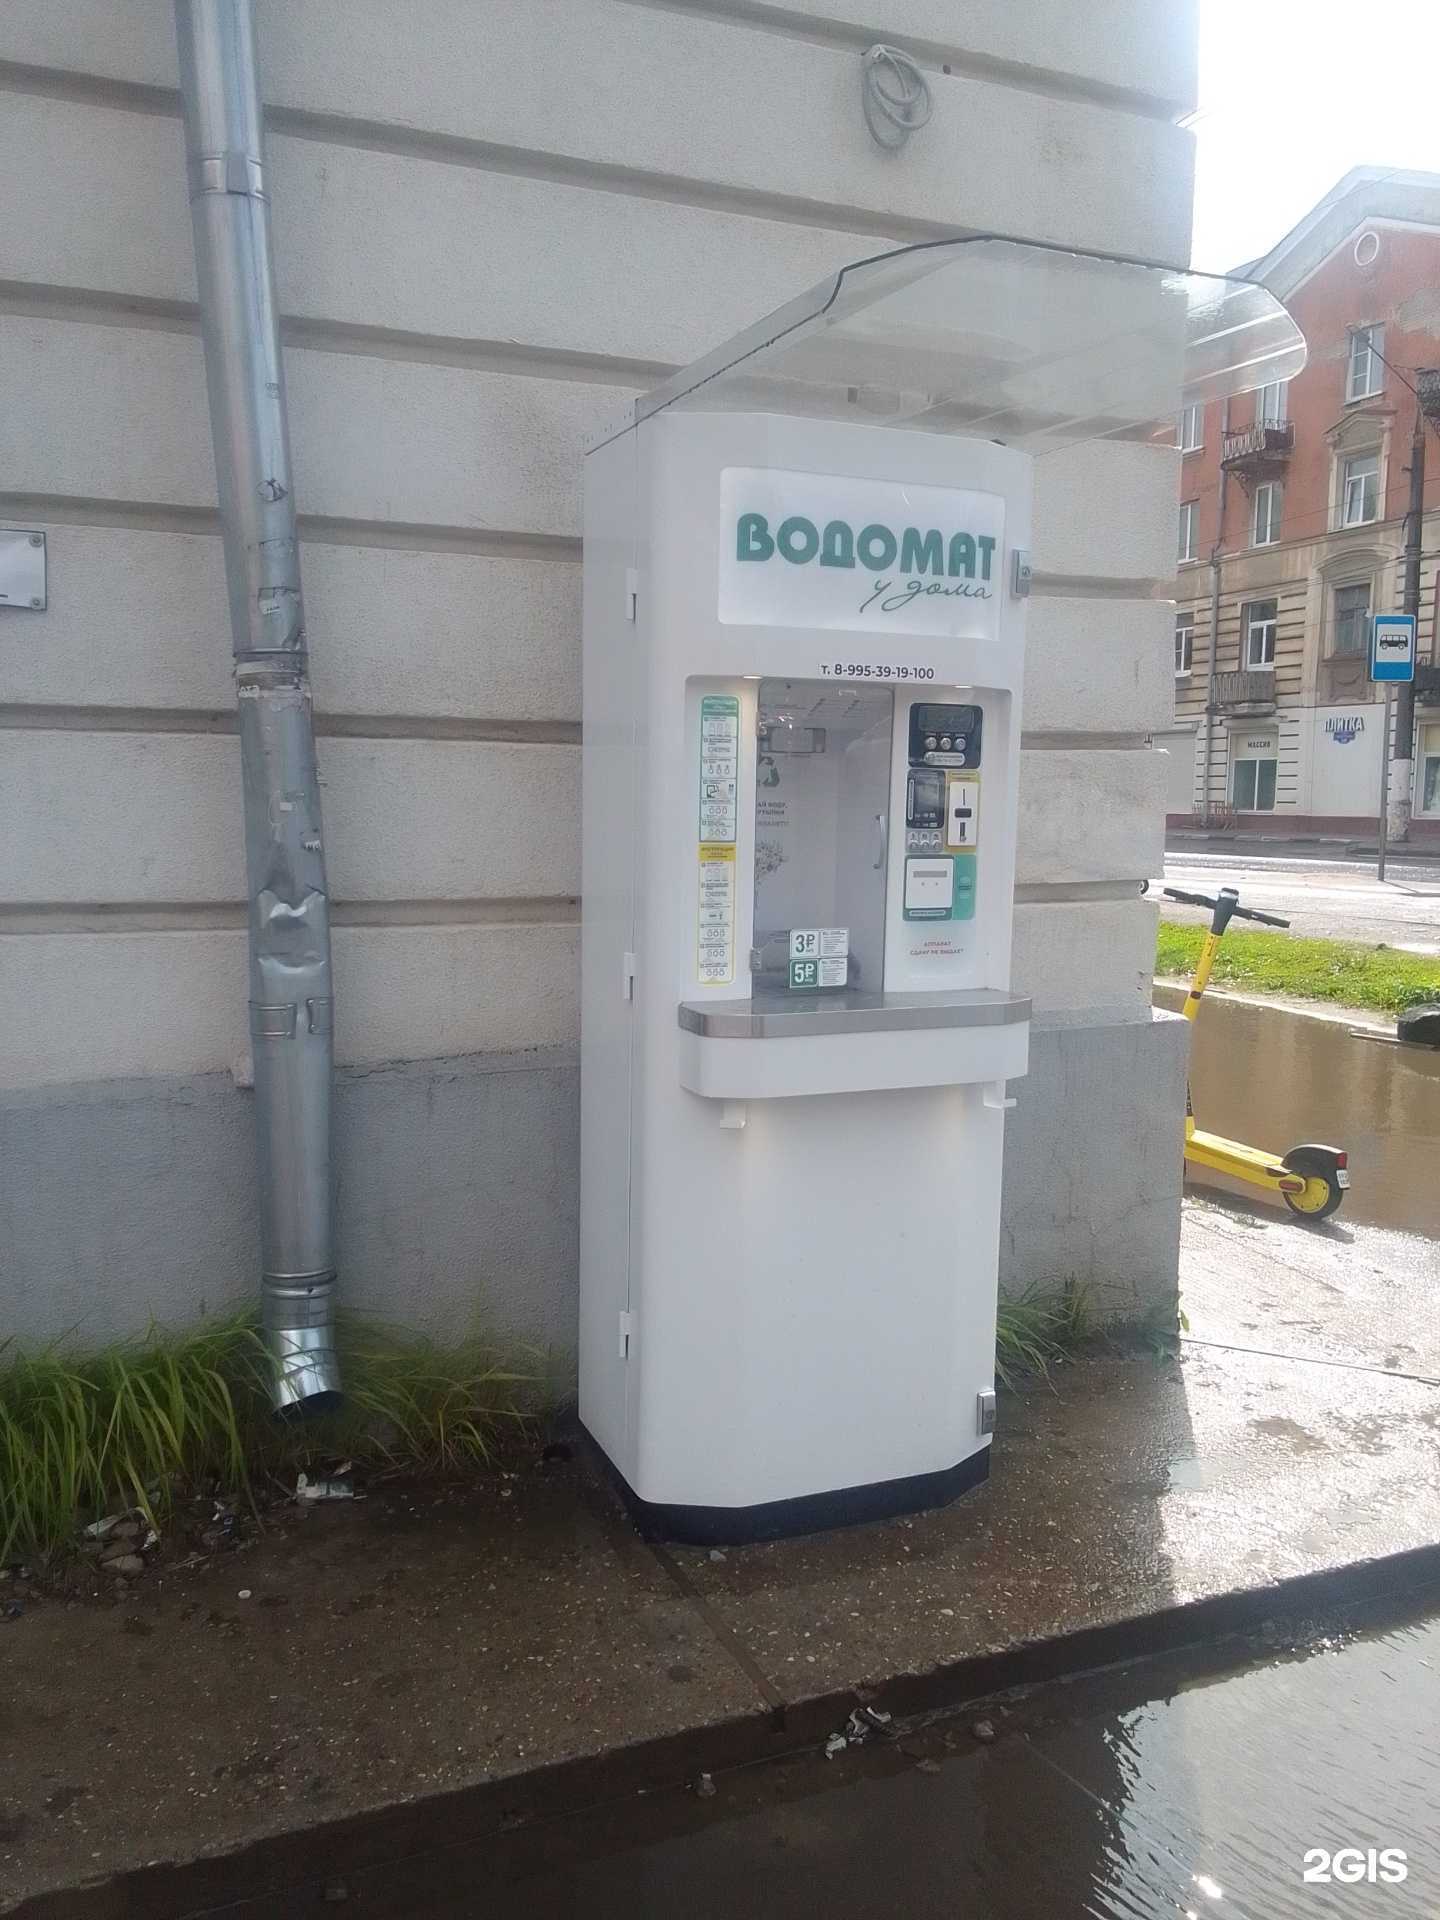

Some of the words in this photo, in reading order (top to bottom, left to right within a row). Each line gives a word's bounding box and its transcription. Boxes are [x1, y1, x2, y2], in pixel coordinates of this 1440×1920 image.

[736, 512, 996, 580] ВОДОМАТ
[881, 580, 992, 612] дома
[834, 663, 934, 679] 8-995-39-19-100
